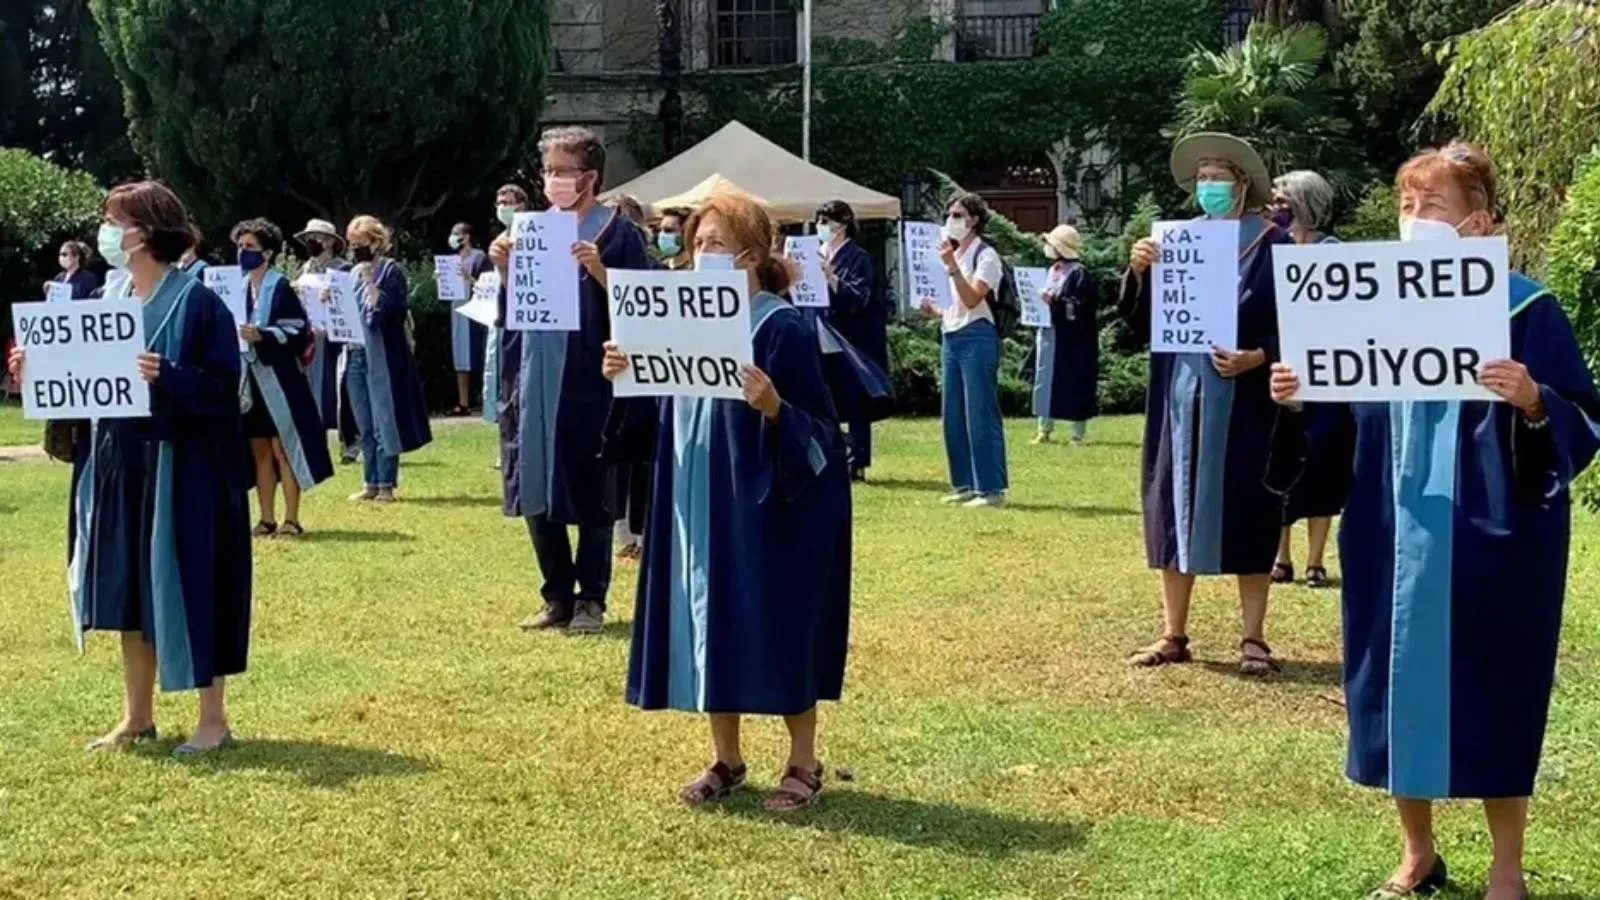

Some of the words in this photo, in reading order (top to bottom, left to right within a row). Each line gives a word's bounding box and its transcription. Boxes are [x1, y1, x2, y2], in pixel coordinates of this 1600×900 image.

[517, 220, 544, 233] KA-
[1162, 229, 1202, 244] KA-
[515, 238, 548, 251] BUL
[515, 256, 541, 269] ET-
[1162, 249, 1204, 264] BUL
[515, 270, 542, 287] Mİ-
[1163, 269, 1195, 284] ET-
[1286, 262, 1379, 302] %95
[1397, 257, 1495, 299] RED
[515, 291, 547, 305] YO-
[613, 284, 669, 317] %95
[678, 285, 740, 318] RED
[1163, 284, 1196, 304] Mİ-
[515, 310, 558, 323] RUZ.
[1163, 310, 1200, 324] YO-
[20, 316, 72, 345] %95
[81, 312, 136, 342] RED
[1162, 330, 1213, 345] RUZ.
[631, 348, 742, 387] EDİYOR
[1307, 338, 1480, 387] EDİYOR
[34, 371, 133, 408] EDİYOR
